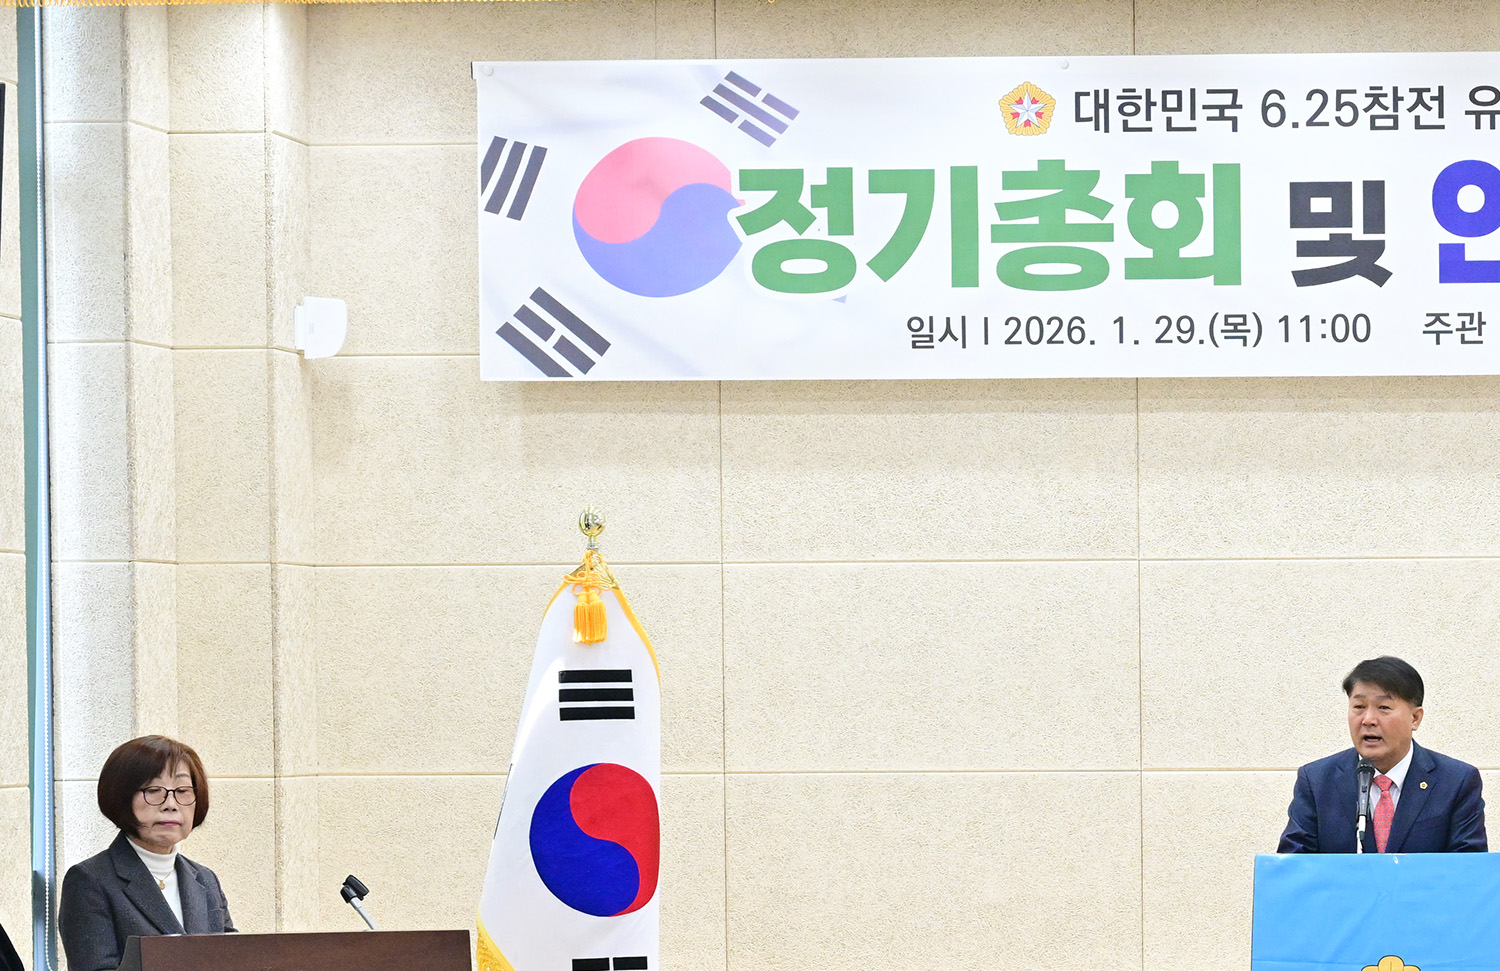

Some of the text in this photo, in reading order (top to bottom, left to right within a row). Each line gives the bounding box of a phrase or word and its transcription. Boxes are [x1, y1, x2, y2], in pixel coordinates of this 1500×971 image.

[1074, 87, 1243, 134] 대한민국
[1261, 85, 1446, 131] 6.25참전
[738, 160, 1241, 294] 정기총회
[1290, 181, 1394, 288] 및
[906, 315, 967, 350] 일시
[1004, 315, 1096, 346] 2026.
[1113, 316, 1140, 345] 1.
[1155, 311, 1263, 348] 29.(목)
[1278, 313, 1371, 343] 11:00
[1422, 311, 1487, 346] 주관
